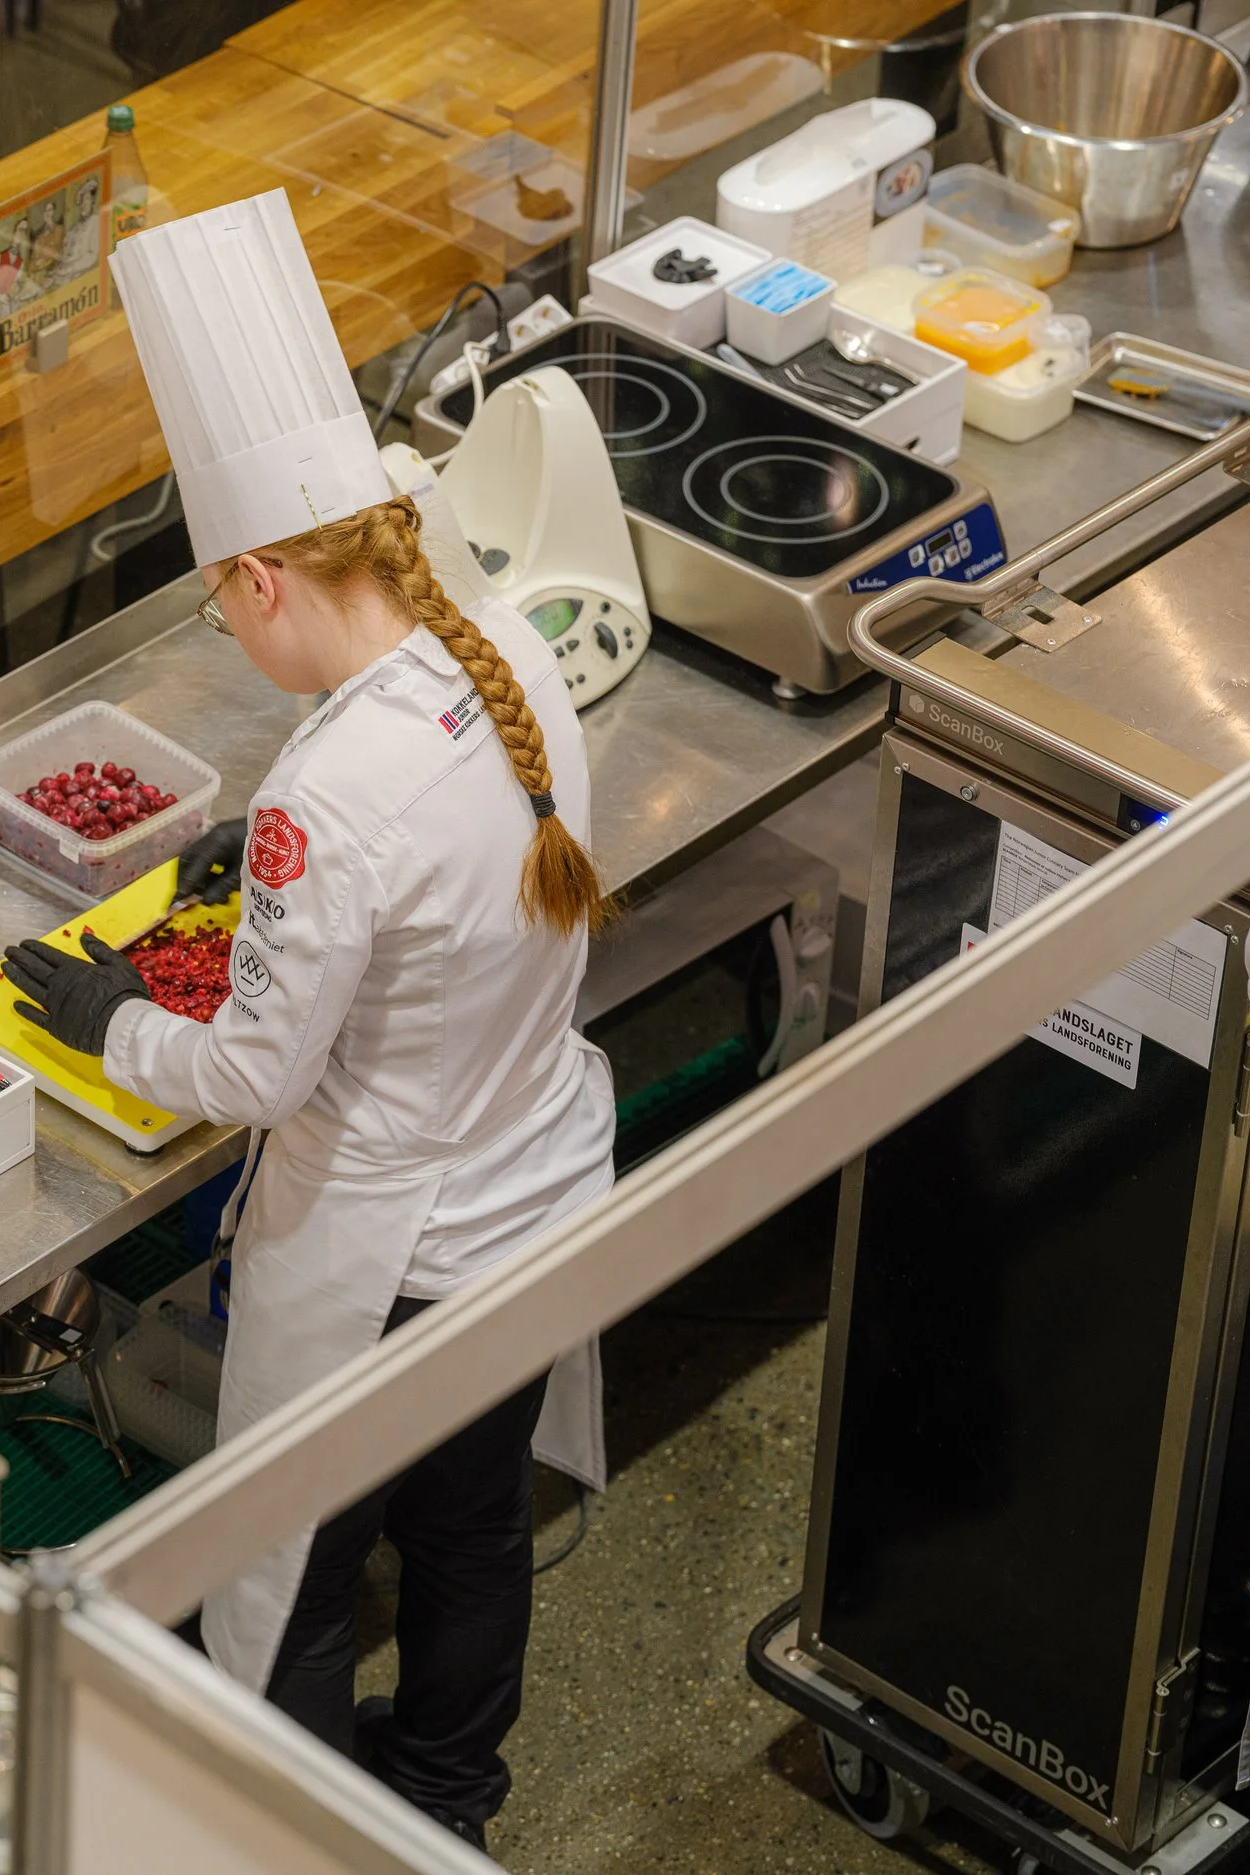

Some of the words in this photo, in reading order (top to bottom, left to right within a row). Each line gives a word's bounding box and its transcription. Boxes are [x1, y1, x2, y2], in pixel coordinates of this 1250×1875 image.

[929, 704, 1004, 755] ScanBox
[277, 819, 299, 878] LANDSFORENING
[1050, 1007, 1134, 1054] ANDSLAGET
[1052, 1022, 1132, 1071] LANDSFORENING
[944, 1685, 1110, 1810] ScanBox
